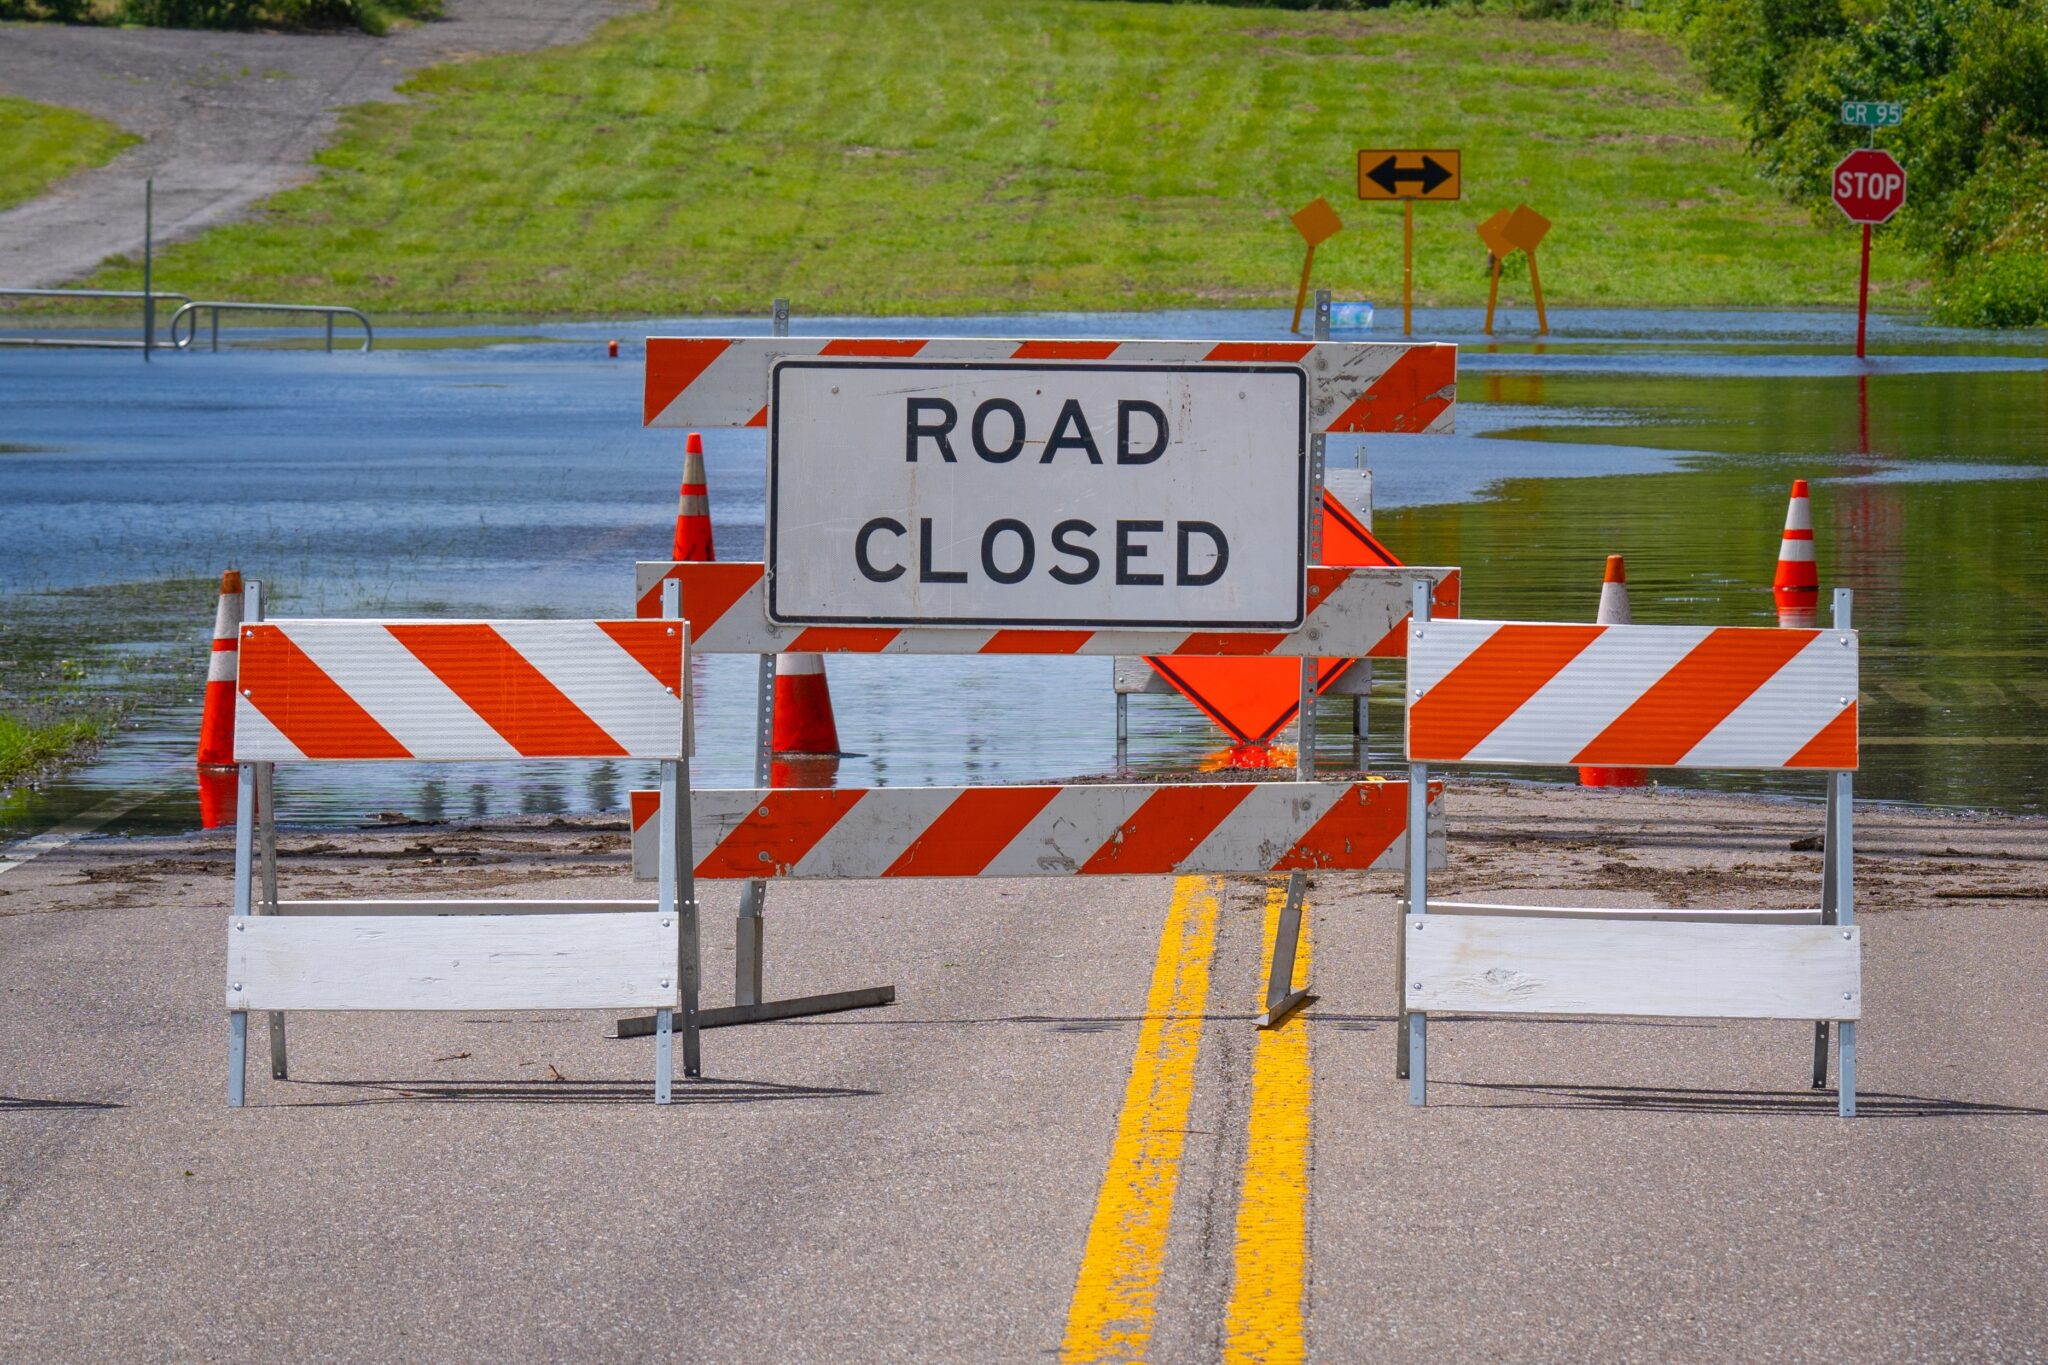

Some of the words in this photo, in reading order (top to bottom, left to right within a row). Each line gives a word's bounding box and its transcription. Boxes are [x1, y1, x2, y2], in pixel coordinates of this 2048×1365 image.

[1844, 104, 1867, 122] CR
[1876, 106, 1900, 124] 95
[1837, 171, 1901, 201] STOP
[906, 398, 1170, 464] ROAD
[855, 517, 1230, 586] CLOSED
